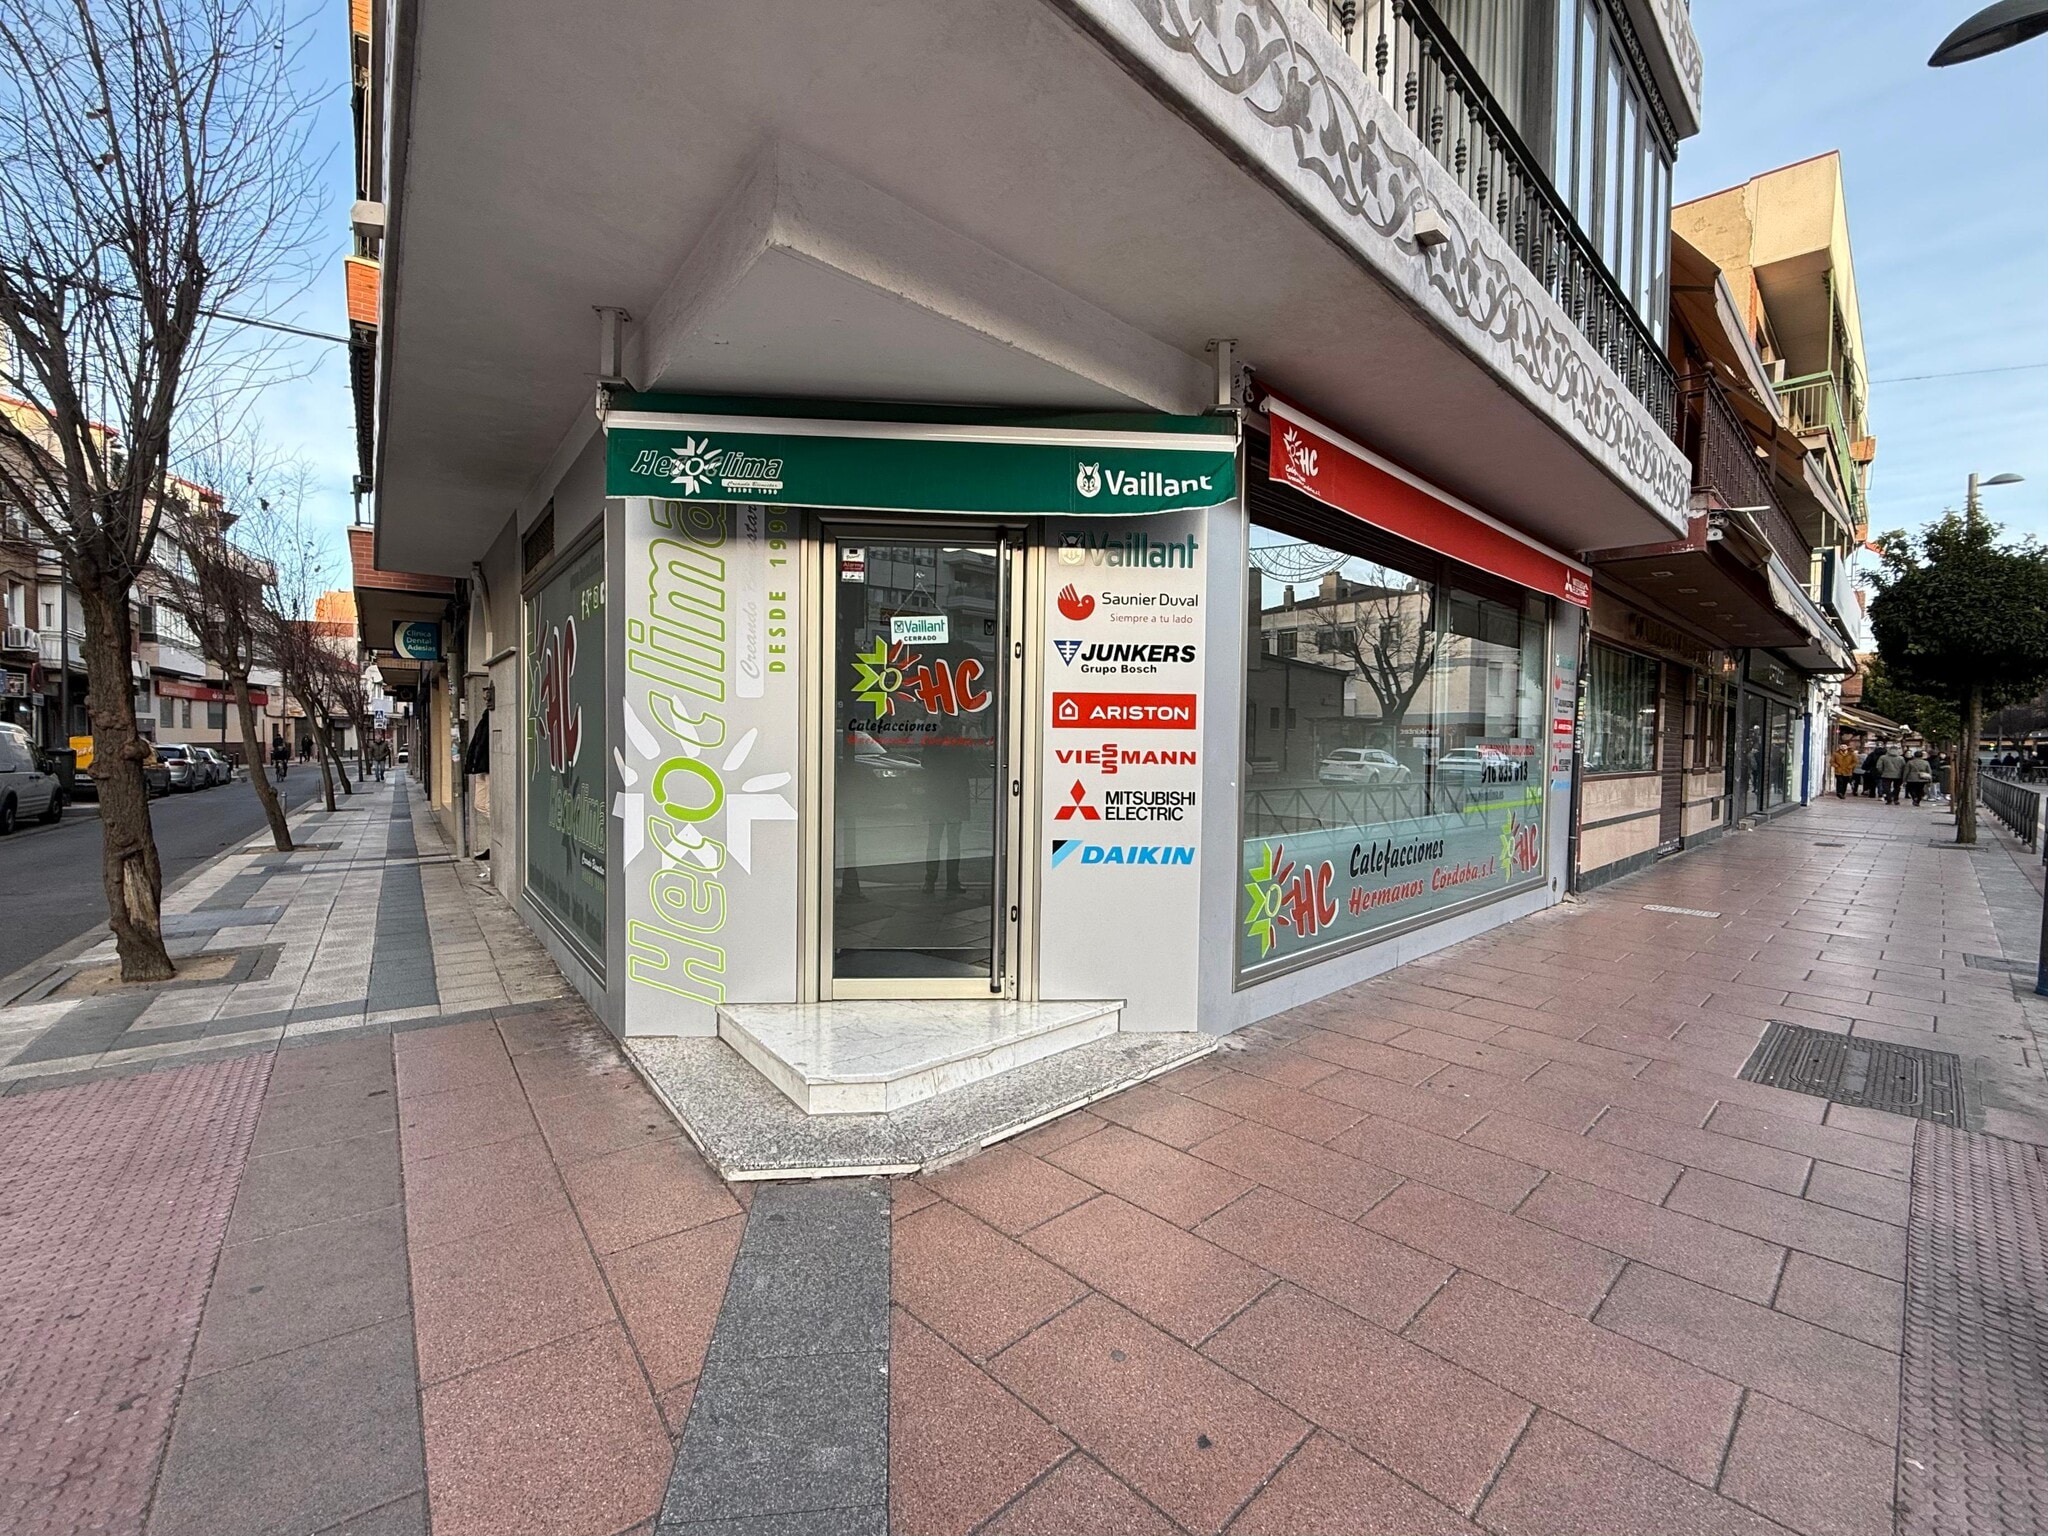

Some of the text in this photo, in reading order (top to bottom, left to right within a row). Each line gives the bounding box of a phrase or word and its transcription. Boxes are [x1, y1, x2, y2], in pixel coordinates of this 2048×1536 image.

[1300, 446, 1319, 476] HC
[1105, 470, 1212, 496] Vaillant
[1090, 531, 1199, 569] Vaillant
[768, 503, 788, 673] DESDE 1990
[1102, 591, 1199, 607] Saunier Duval
[904, 619, 946, 633] Vaillant
[1110, 613, 1149, 624] Siempre
[1160, 614, 1170, 623] tu
[1172, 614, 1193, 624] lado
[406, 636, 432, 645] Dental
[1081, 643, 1196, 663] JUNKERS
[1081, 665, 1157, 675] Grupo Bosch
[545, 614, 582, 773] HC
[914, 658, 993, 717] HC
[1090, 706, 1189, 721] ARISTON
[848, 718, 938, 734] Calefacciones
[1055, 743, 1197, 774] VIESSMANN
[1105, 791, 1196, 806] MITSUBISHI
[1105, 806, 1184, 821] ELECTRIC
[1080, 846, 1196, 865] DAIKIN
[1350, 837, 1444, 878] Calefacciones
[1517, 822, 1540, 873] HC
[1290, 860, 1340, 938] HC
[1349, 879, 1425, 917] Hermanos
